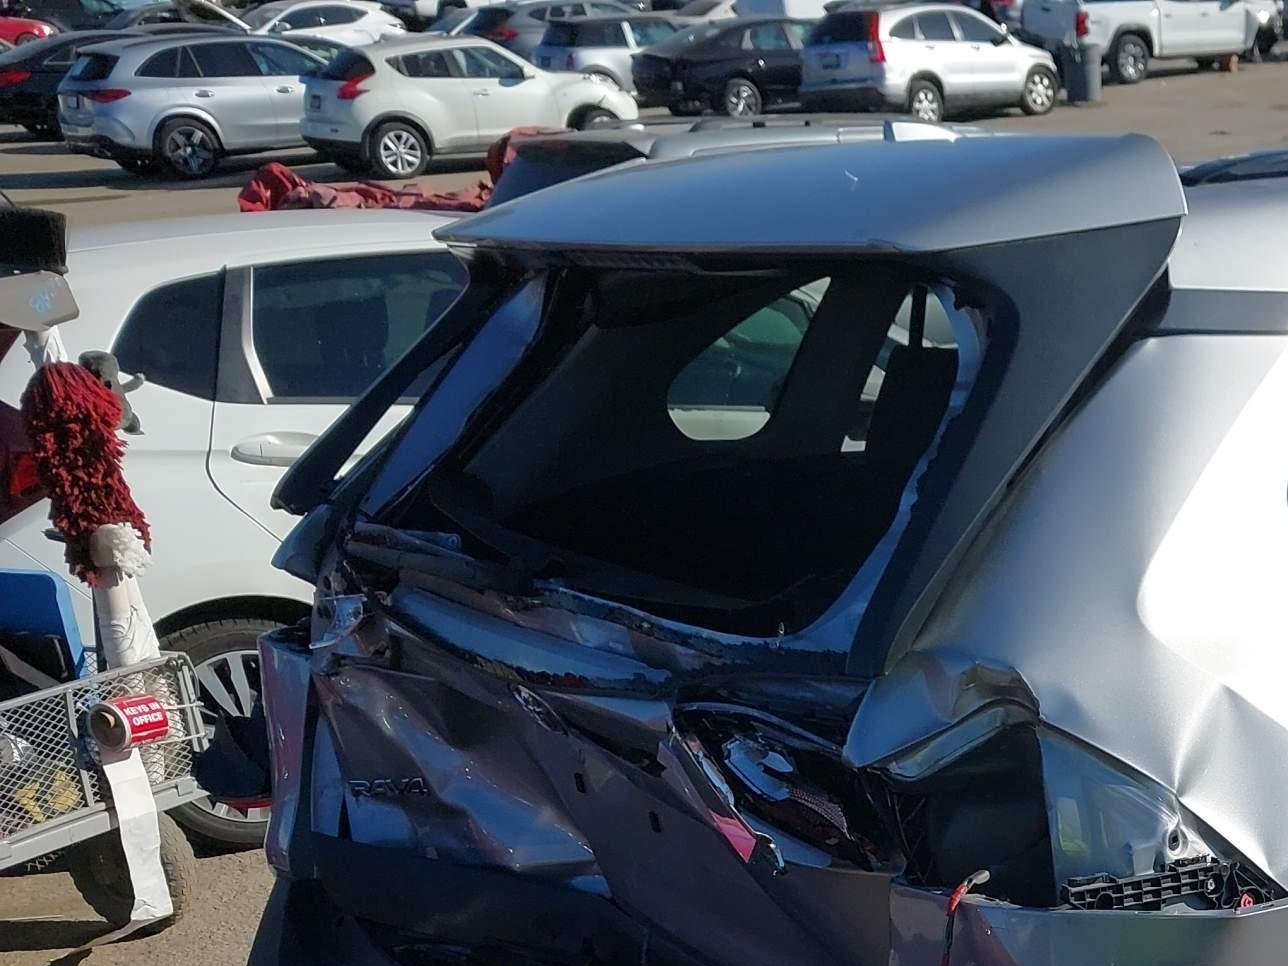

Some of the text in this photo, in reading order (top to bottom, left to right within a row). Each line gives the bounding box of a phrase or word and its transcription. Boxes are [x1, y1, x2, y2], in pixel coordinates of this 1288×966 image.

[123, 701, 161, 716] KEYS IN
[132, 711, 164, 727] OFFICE
[348, 777, 428, 798] RAV4
